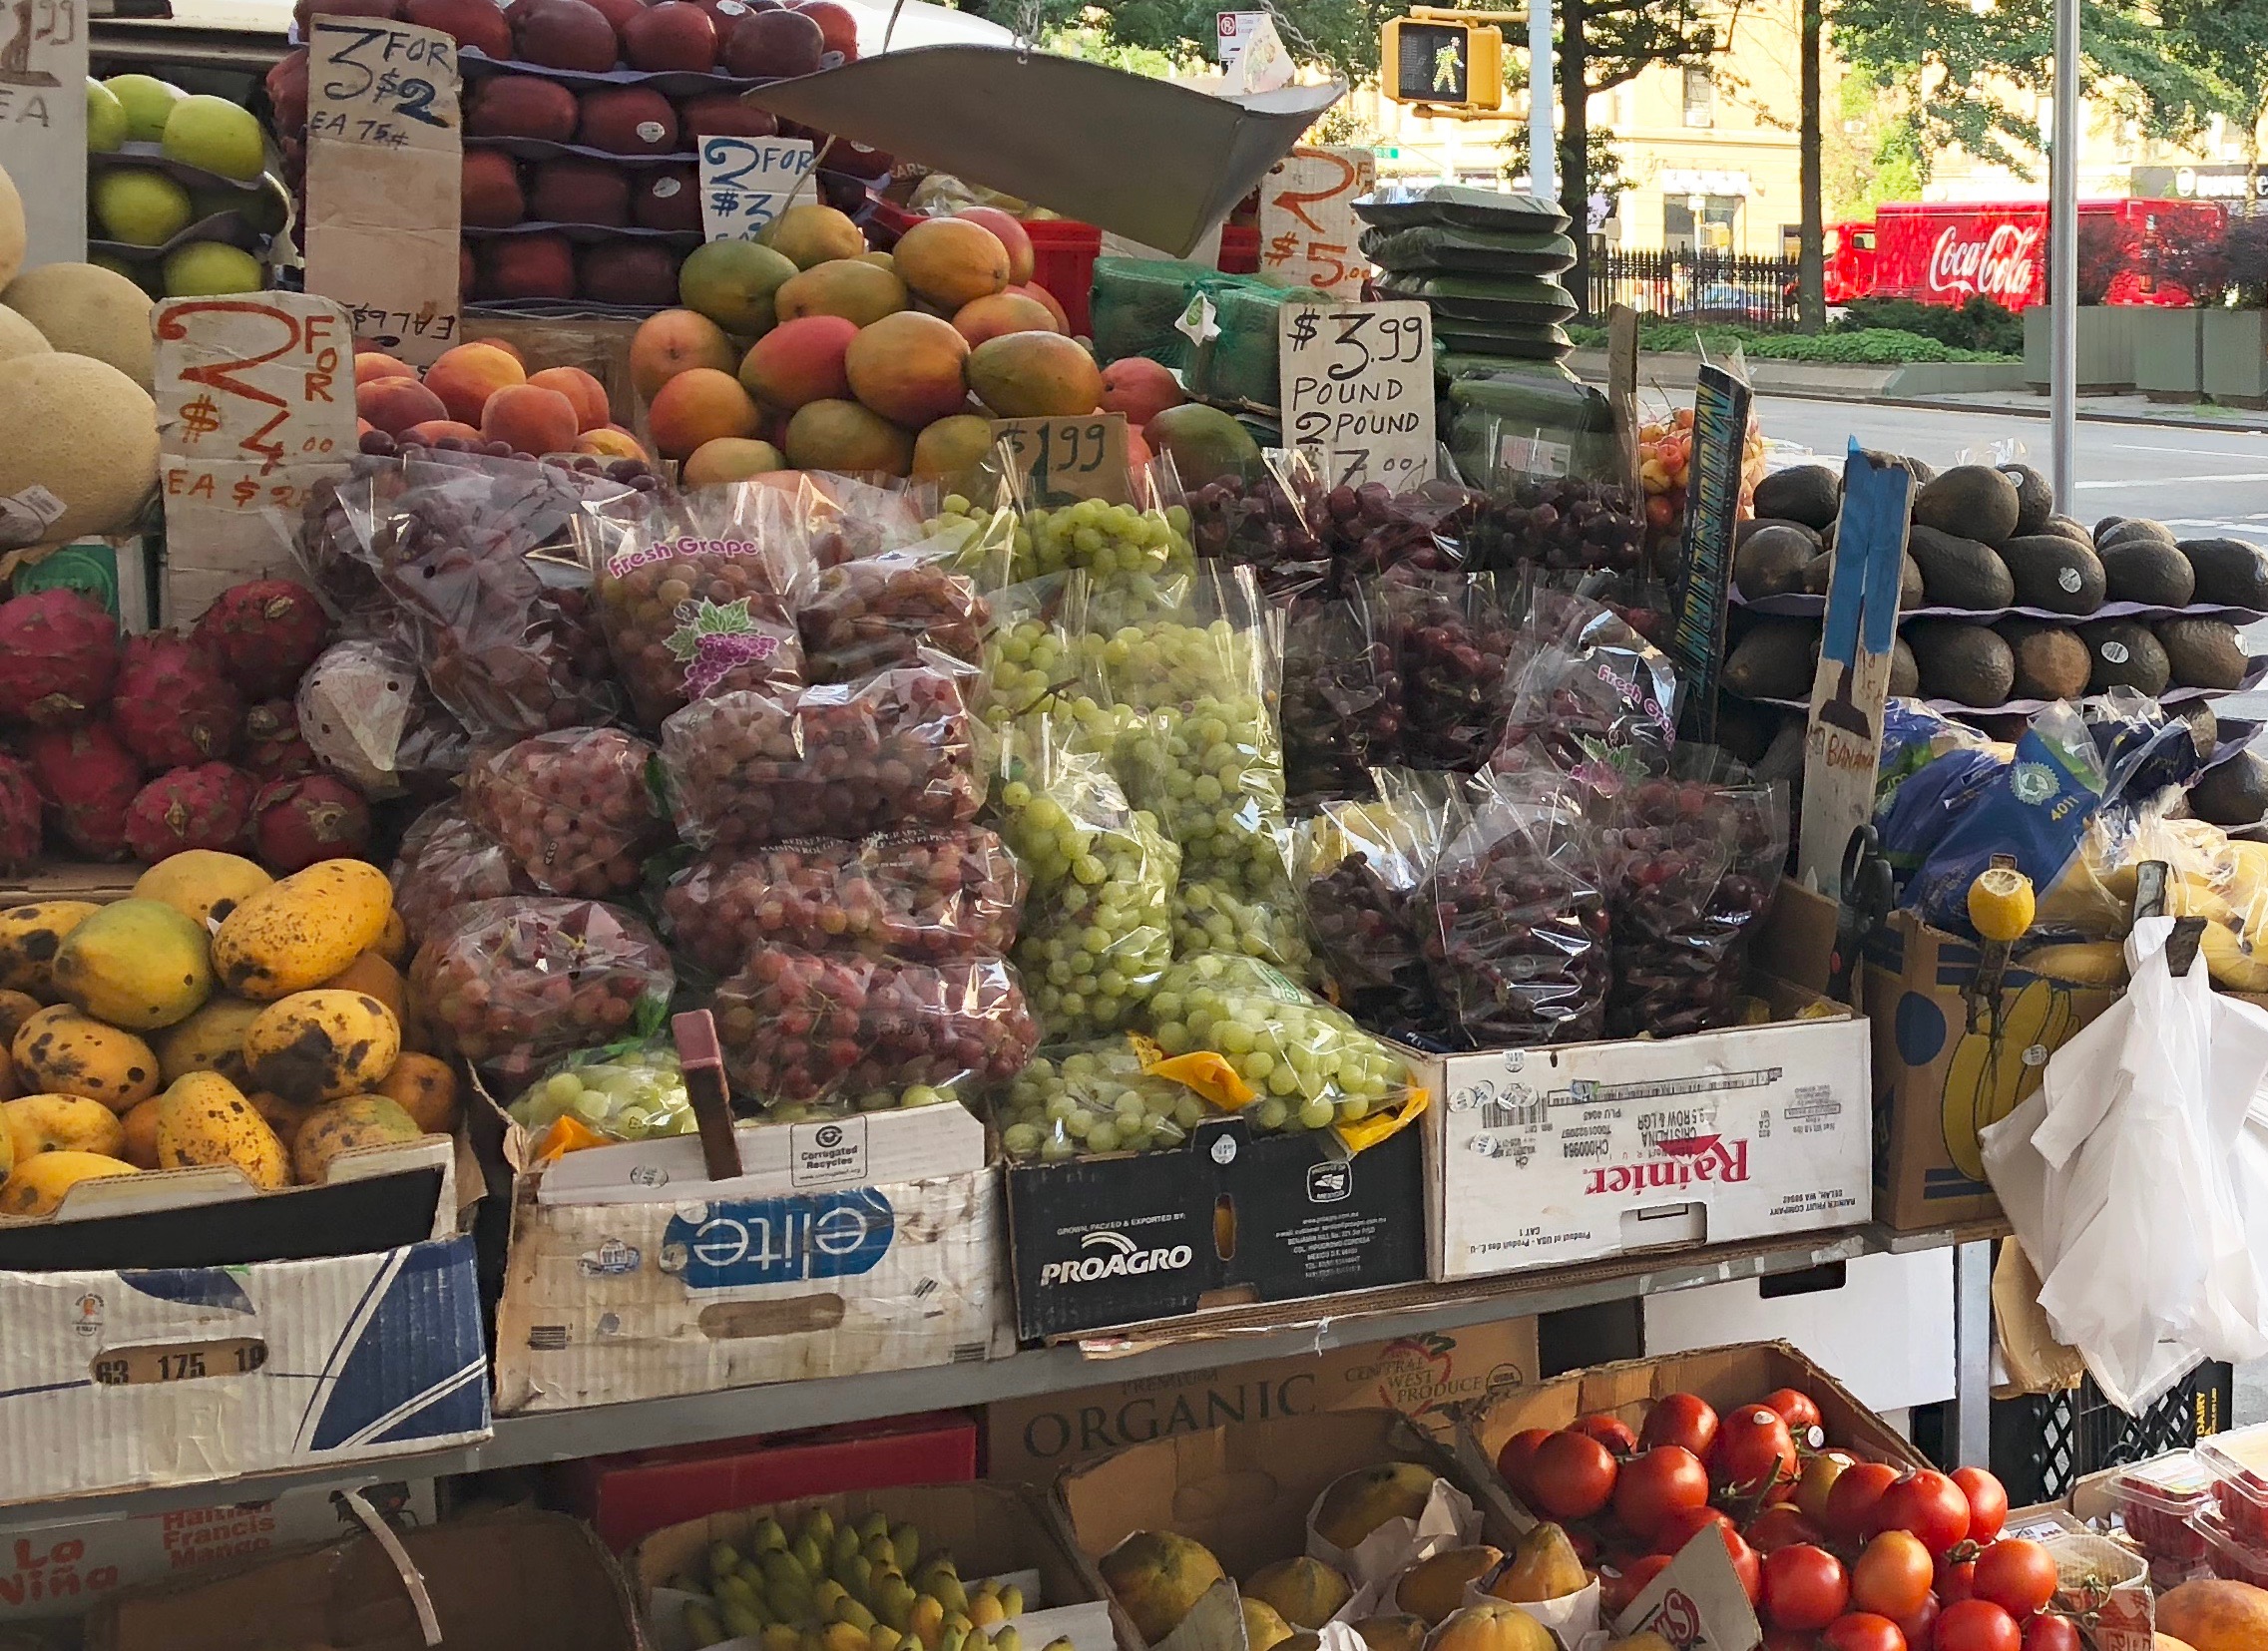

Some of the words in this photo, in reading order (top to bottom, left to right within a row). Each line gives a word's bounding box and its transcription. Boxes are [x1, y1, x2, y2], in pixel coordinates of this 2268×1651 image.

[316, 23, 387, 100] 3
[383, 32, 453, 73] FOR
[310, 111, 346, 135] EA
[704, 138, 759, 191] 2
[762, 147, 814, 175] FOR
[1930, 225, 2040, 293] Coca-Cola
[158, 301, 300, 408] 2
[1293, 377, 1404, 412] POUND
[1295, 412, 1332, 445] 2
[1331, 412, 1420, 443] POUND
[168, 469, 215, 500] EA
[677, 536, 758, 557] Grape
[1597, 663, 1642, 704] Fresh
[1643, 697, 1676, 751] Grap
[2050, 795, 2079, 822] 4011
[1604, 1108, 1621, 1119] PLU
[1658, 1112, 1666, 1128] &
[1667, 1110, 1690, 1126] ROW
[801, 1145, 858, 1160] Corrugated
[806, 1157, 853, 1169] Recycles
[1585, 1138, 1751, 1196] Rainier
[1131, 1213, 1172, 1226] EXPORTED
[1769, 1204, 1805, 1216] COMPANY
[1806, 1202, 1826, 1211] FRUIT
[692, 1206, 868, 1281] elite
[1526, 1226, 1540, 1236] CAT
[1537, 1235, 1553, 1246] USA
[1563, 1232, 1590, 1243] Product
[1040, 1245, 1192, 1287] PROAGRO
[158, 1352, 206, 1380] 175
[1344, 1357, 1425, 1383] CENTRAL
[1388, 1369, 1435, 1390] WEST
[1397, 1376, 1483, 1404] PRODUCE
[1024, 1373, 1316, 1458] ORGANIC
[163, 1516, 276, 1550] Francis
